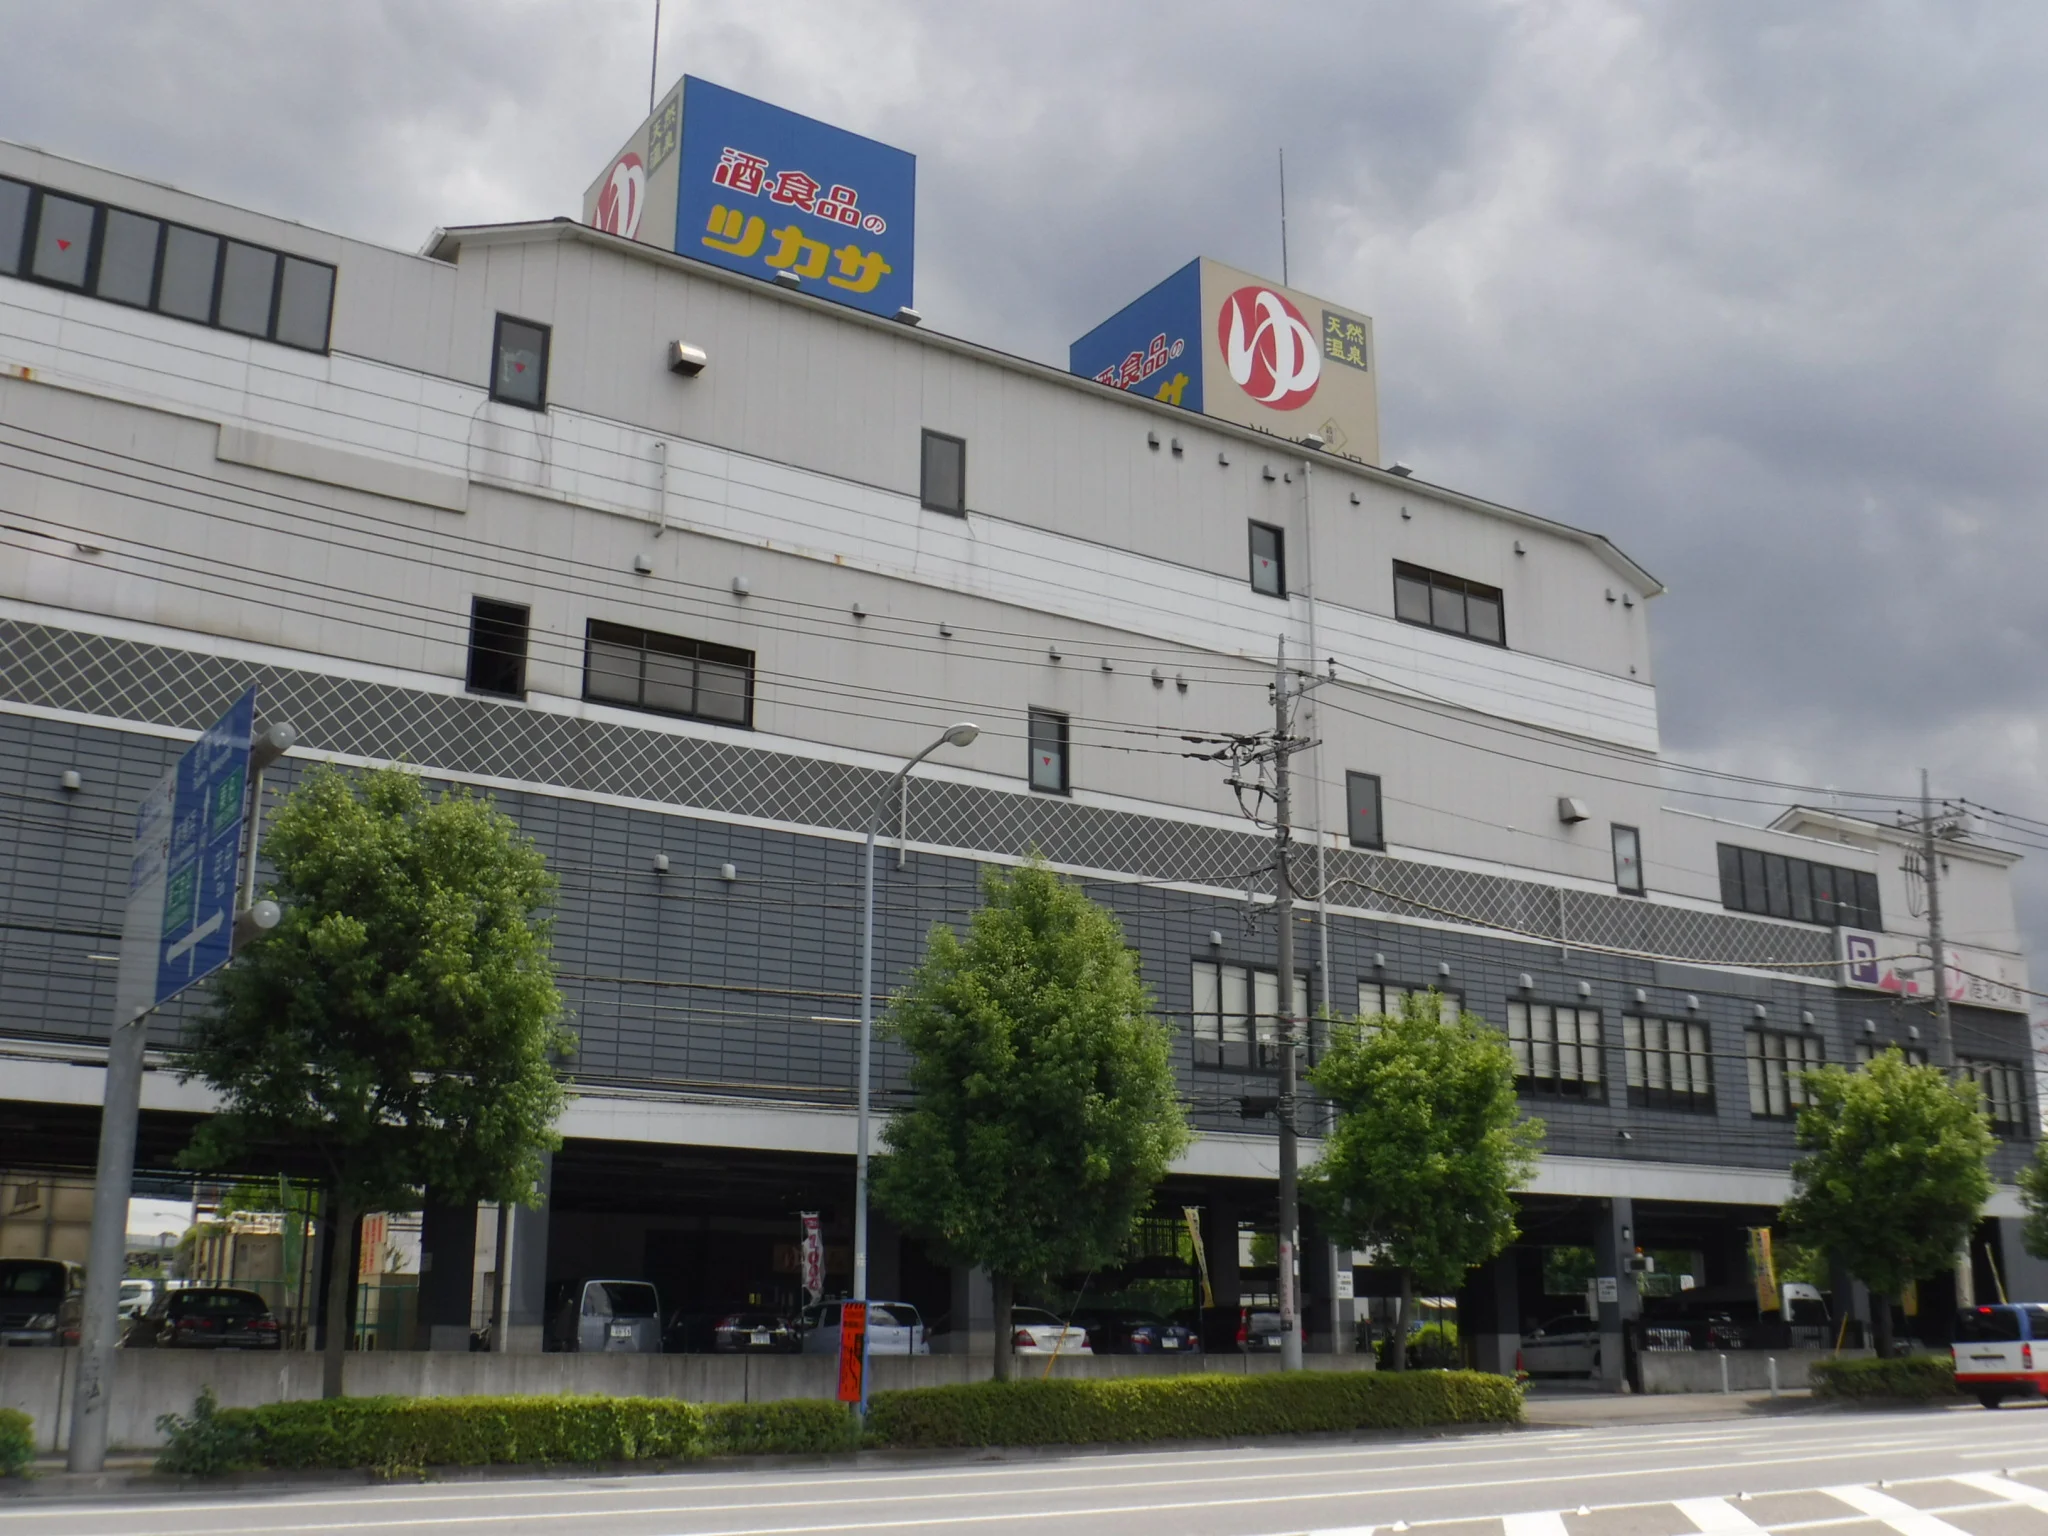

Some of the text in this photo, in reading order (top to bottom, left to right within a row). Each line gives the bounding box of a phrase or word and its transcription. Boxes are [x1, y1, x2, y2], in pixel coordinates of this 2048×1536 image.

[701, 204, 892, 293] ツカサ
[1227, 290, 1321, 402] ゆ
[1325, 316, 1365, 346] 天然
[1323, 337, 1366, 368] 温泉
[1850, 940, 1873, 977] P
